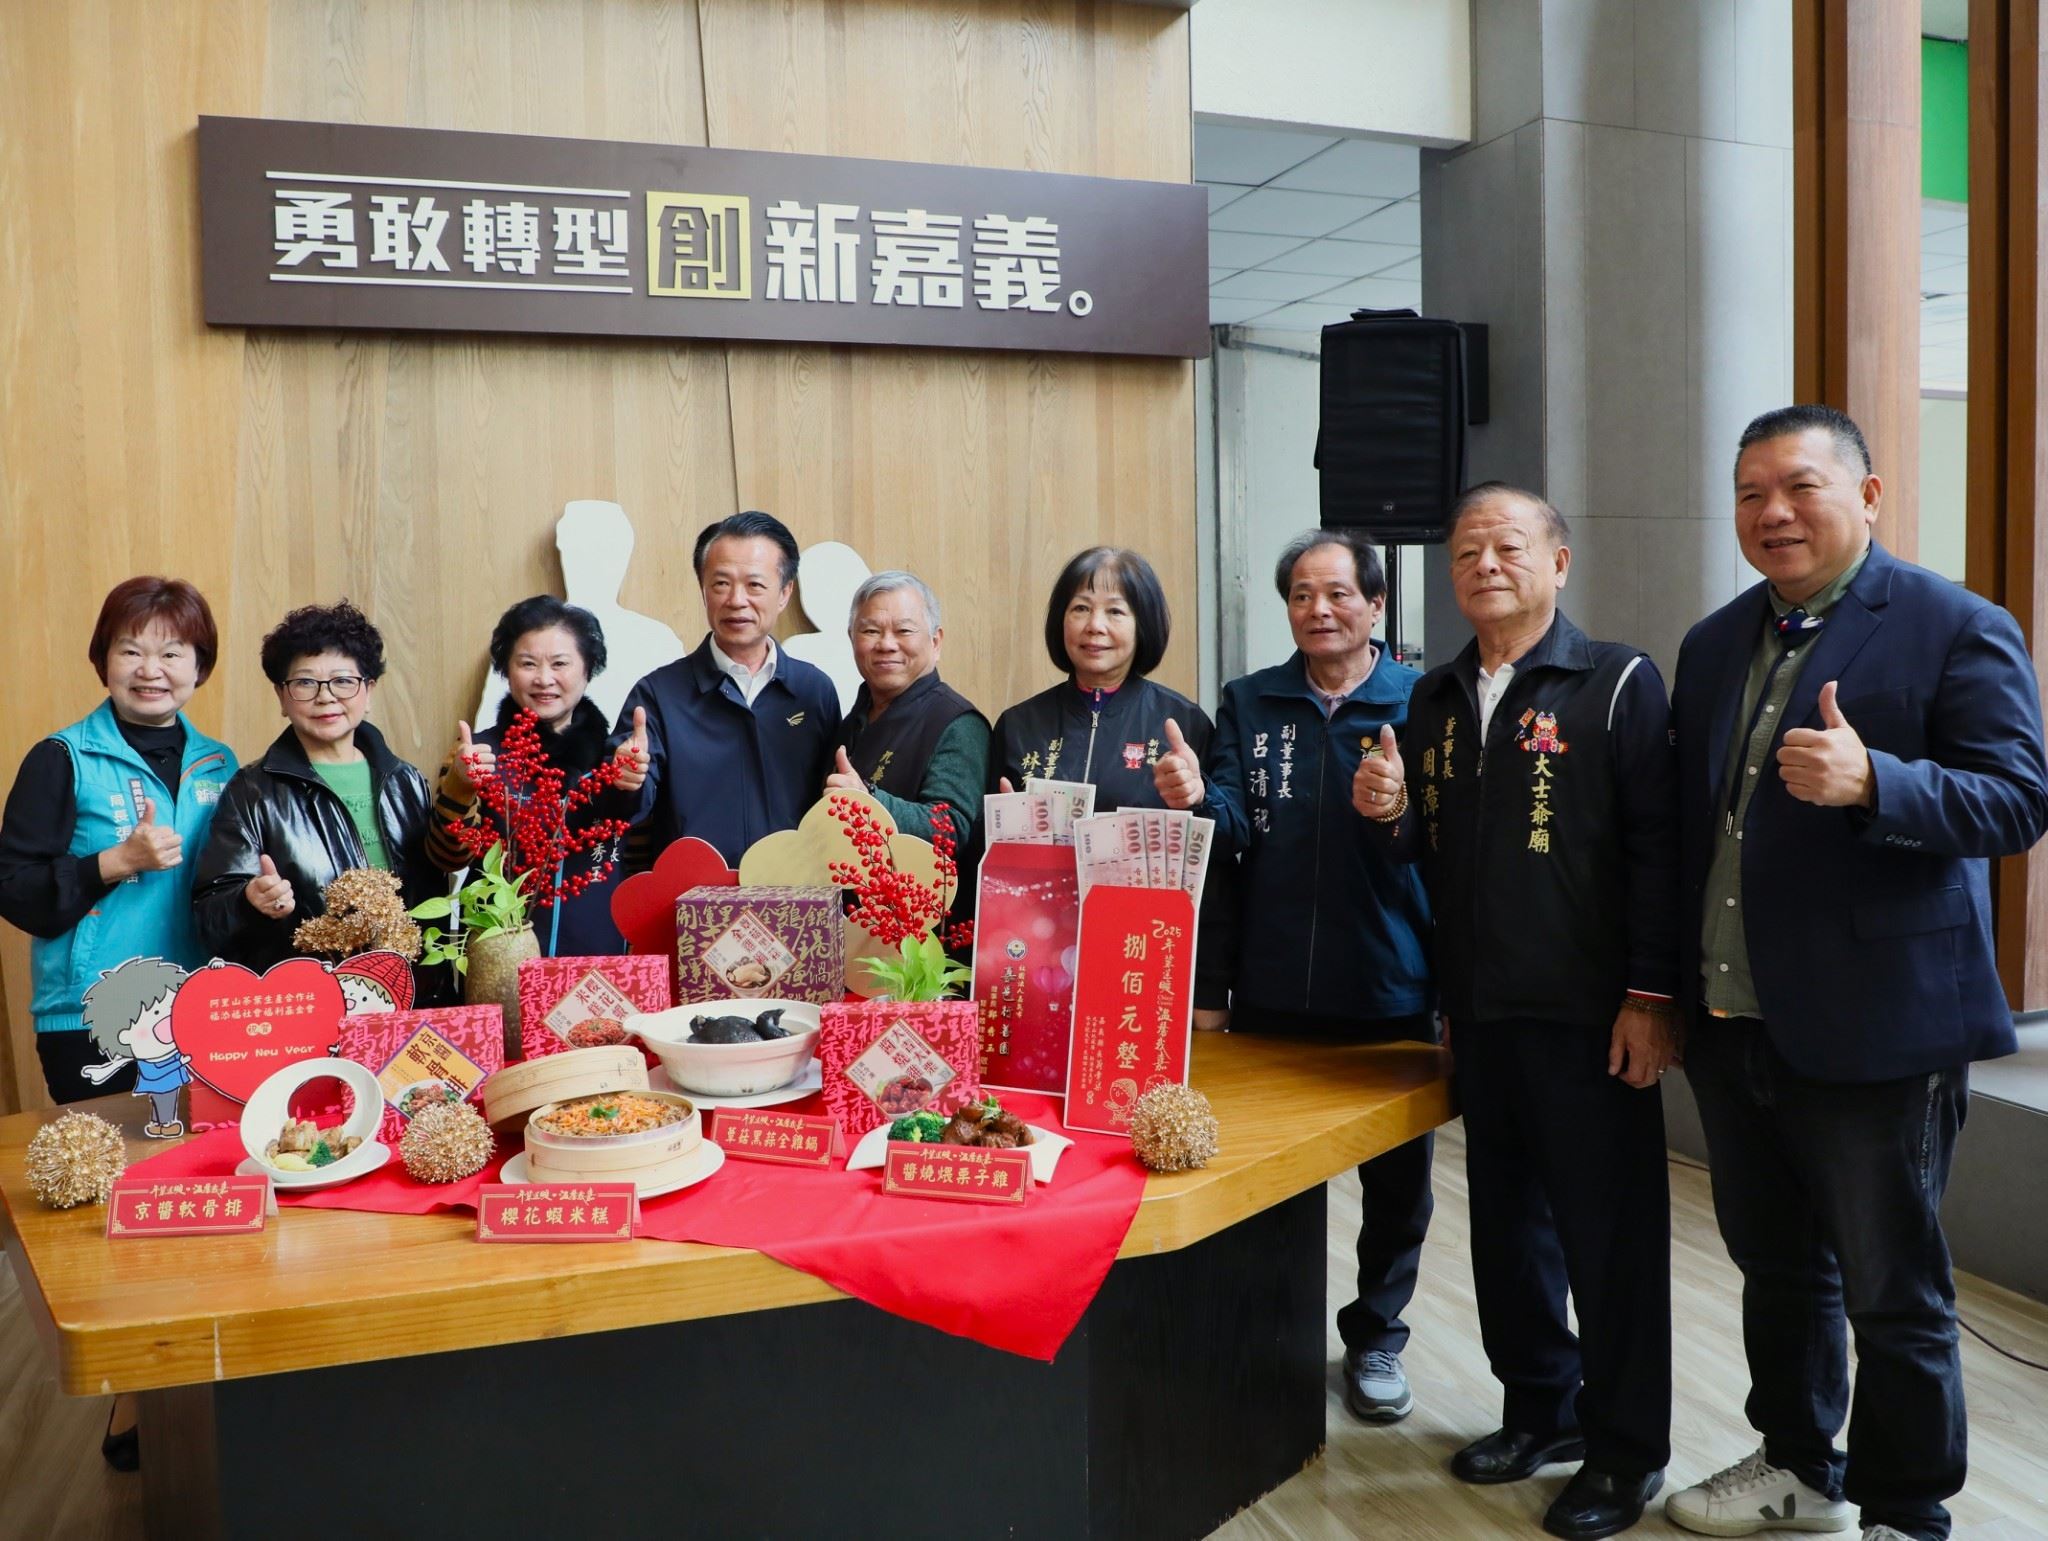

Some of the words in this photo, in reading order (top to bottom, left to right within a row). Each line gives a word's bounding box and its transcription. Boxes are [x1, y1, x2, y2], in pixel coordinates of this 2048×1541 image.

[1277, 723, 1296, 799] 副董事長
[1035, 800, 1049, 832] 100
[1070, 796, 1085, 829] 50
[1527, 753, 1554, 854] 大士爺廟
[1126, 821, 1141, 854] 100
[1148, 820, 1161, 853] 100
[1168, 821, 1182, 854] 100
[1187, 830, 1204, 866] 500
[209, 992, 316, 1008] 阿里山茶葉生產合作社
[1116, 932, 1147, 1070] 捌佰元整
[209, 1051, 249, 1062] Happy
[255, 1048, 279, 1057] New
[284, 1045, 316, 1055] Year
[902, 1162, 1009, 1188] 醬燒煨栗子雞
[135, 1198, 243, 1221] 京醬軟骨排
[501, 1206, 609, 1226] 櫻花蝦米糕
